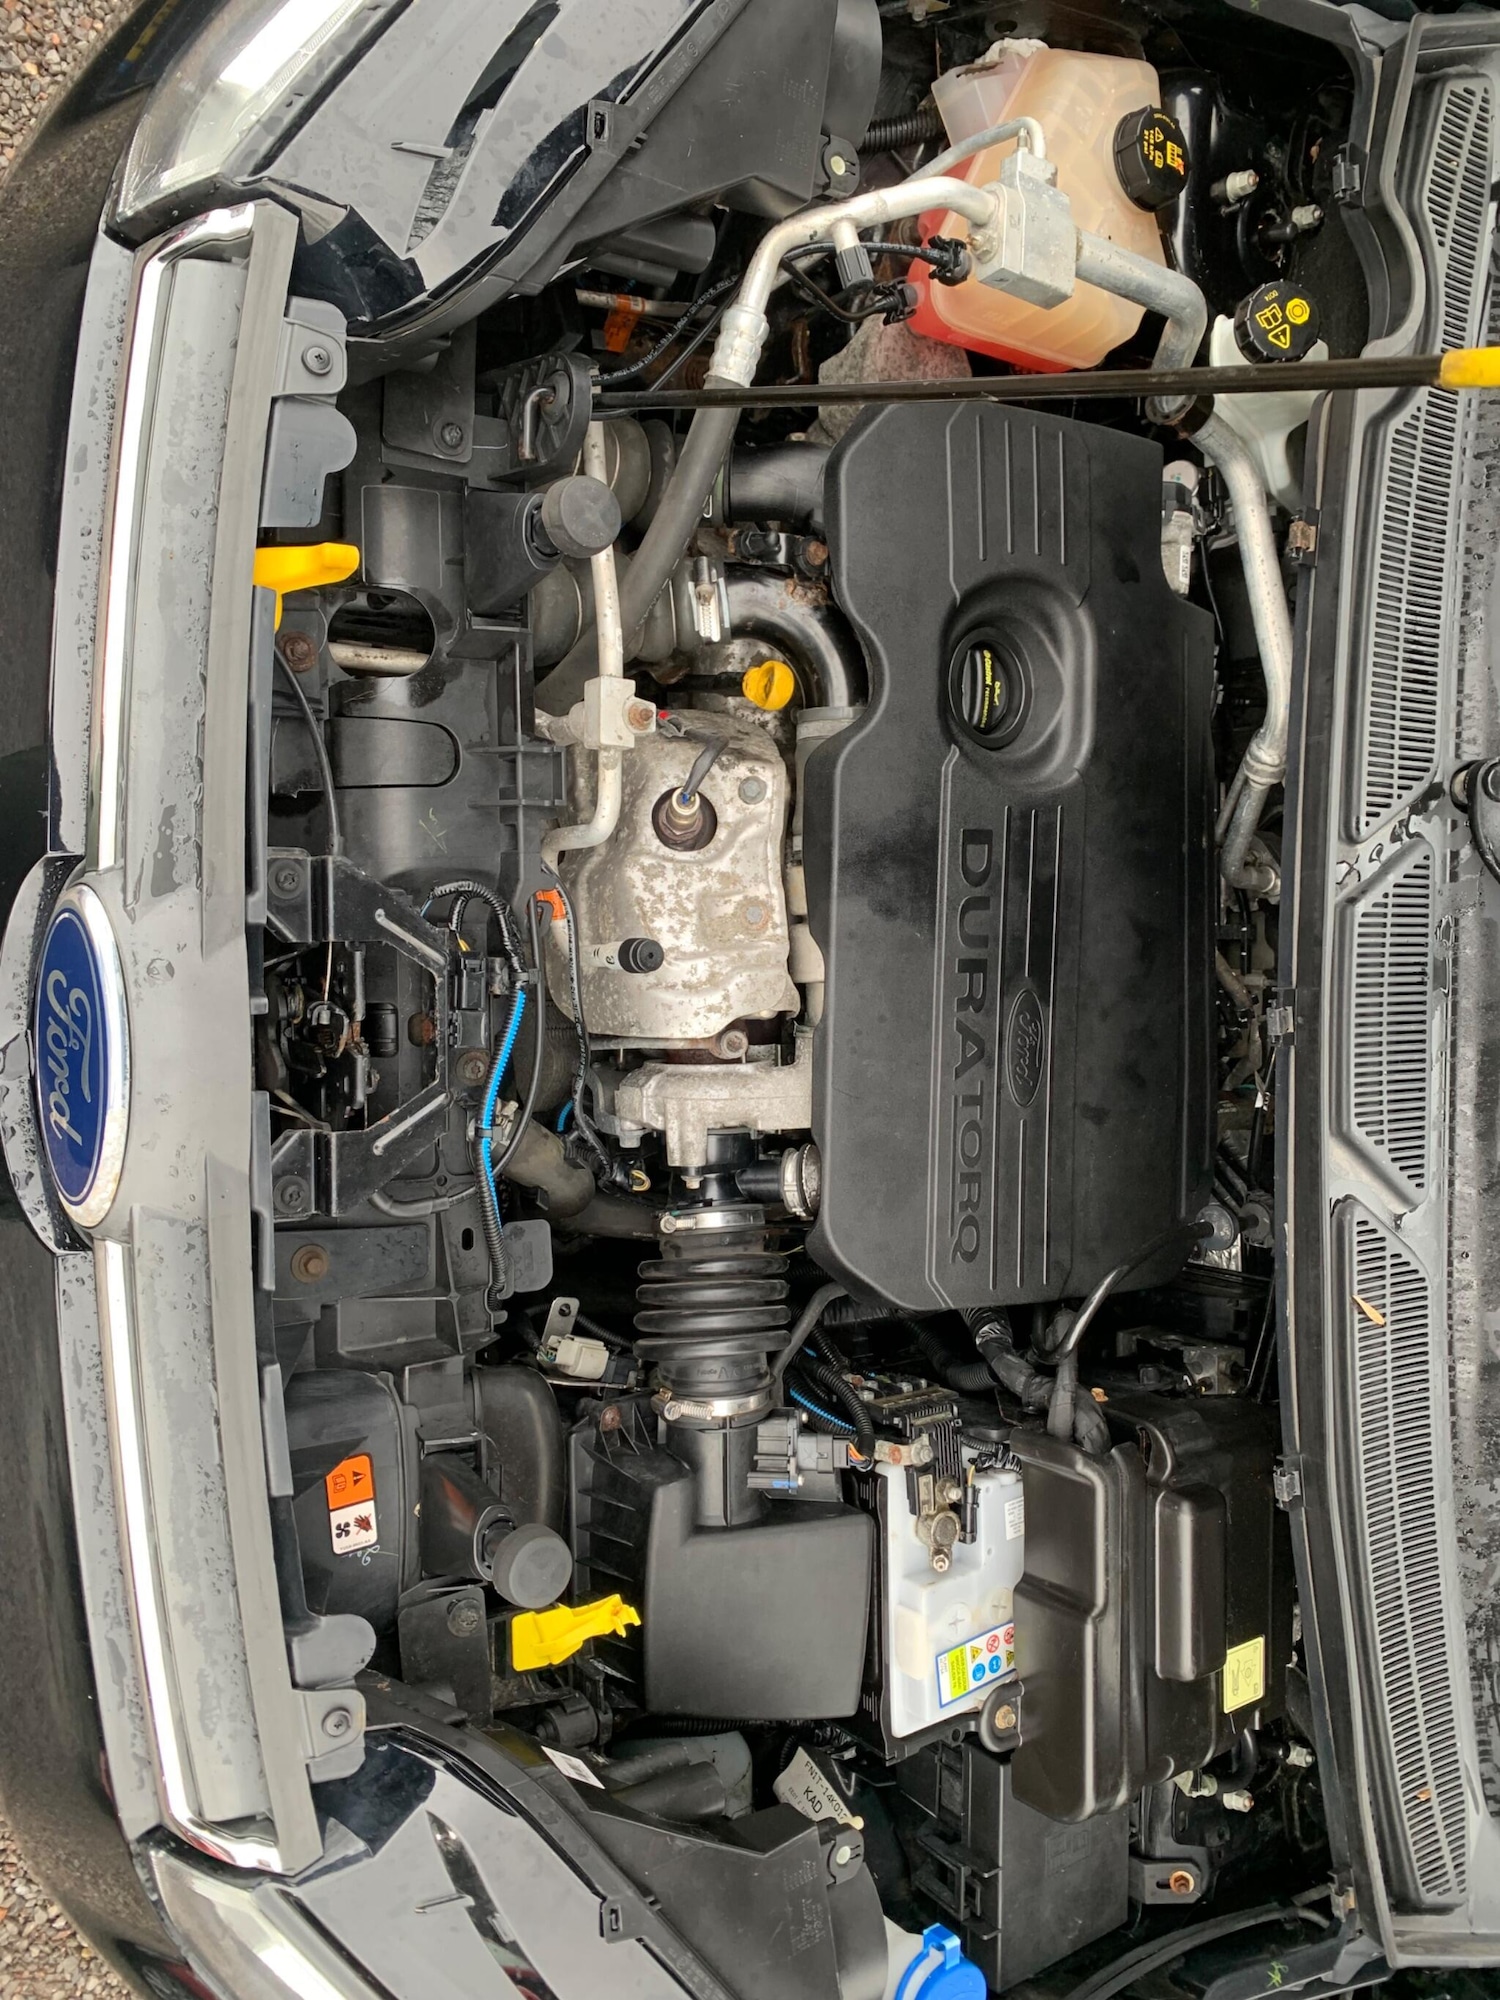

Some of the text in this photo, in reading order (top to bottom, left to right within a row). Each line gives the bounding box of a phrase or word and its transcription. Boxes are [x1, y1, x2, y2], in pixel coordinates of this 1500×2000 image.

[980, 687, 990, 728] recommended
[44, 968, 93, 1147] Ford
[950, 828, 995, 1263] DURATORQ
[1015, 1011, 1042, 1087] Ford
[803, 1786, 822, 1813] KAD
